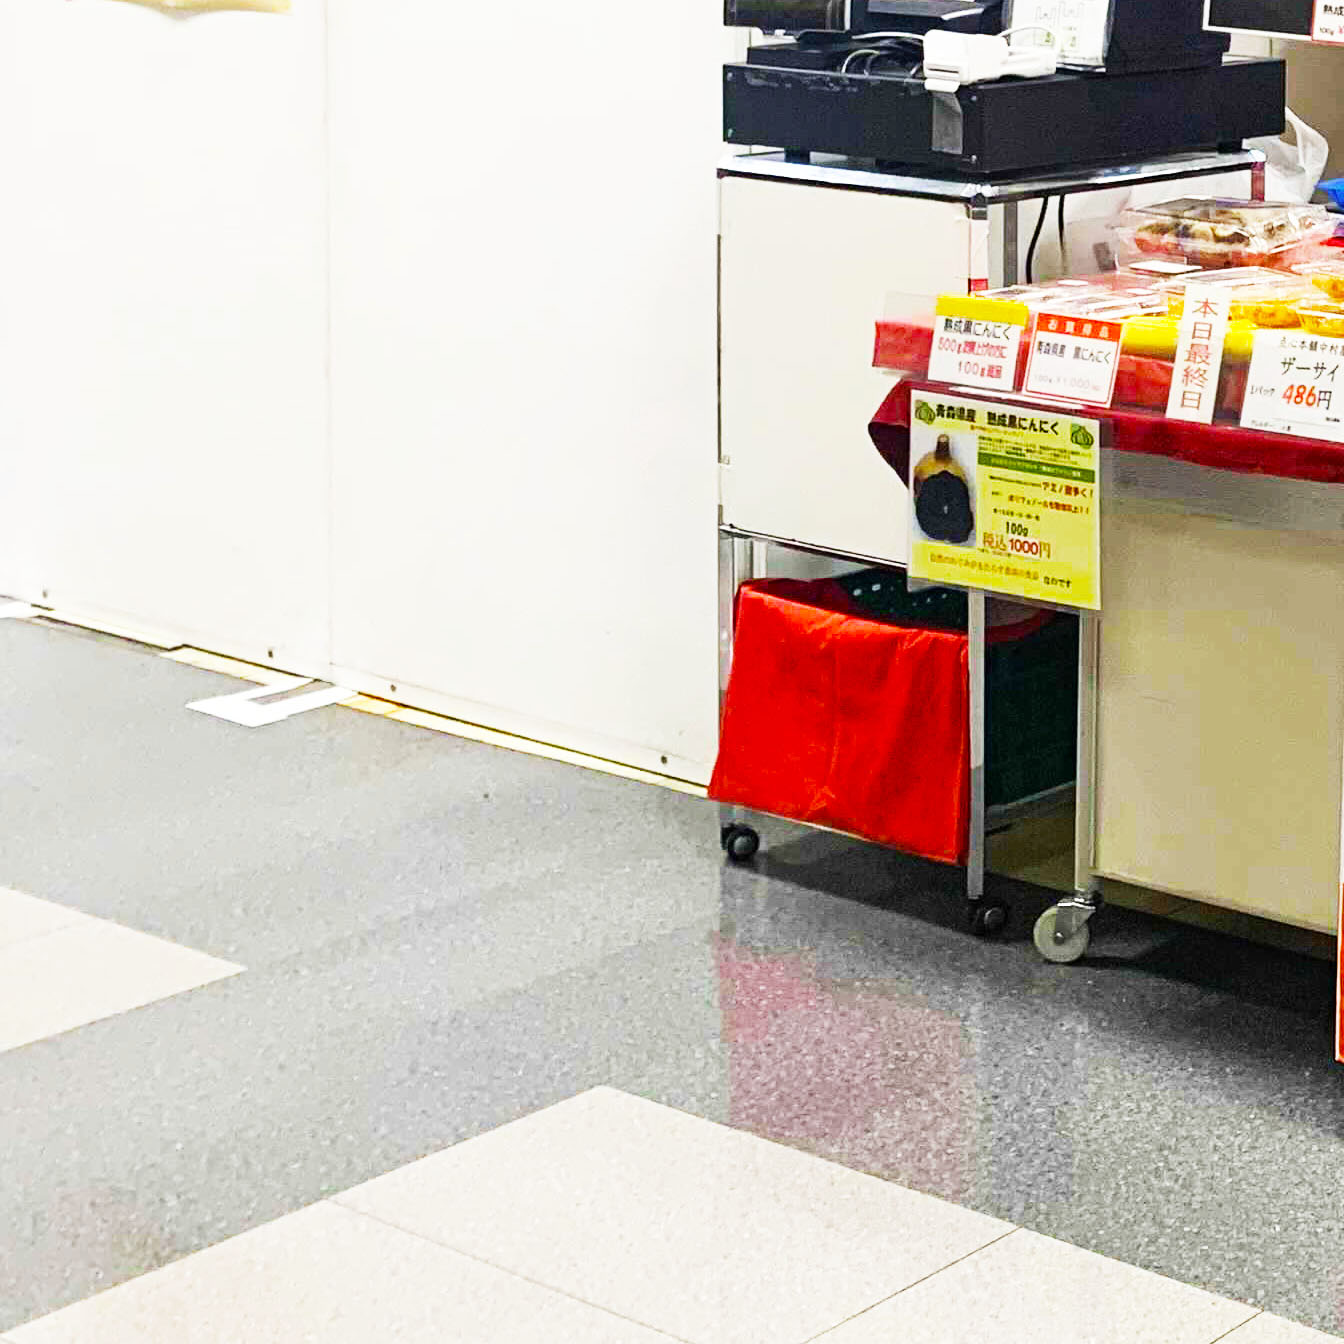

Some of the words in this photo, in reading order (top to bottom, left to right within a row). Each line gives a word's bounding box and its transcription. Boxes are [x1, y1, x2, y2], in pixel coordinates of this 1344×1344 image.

[1180, 298, 1219, 412] 本日最終日
[1281, 357, 1340, 382] ザーサイ
[1281, 384, 1333, 410] 486円
[1005, 521, 1029, 537] 100g
